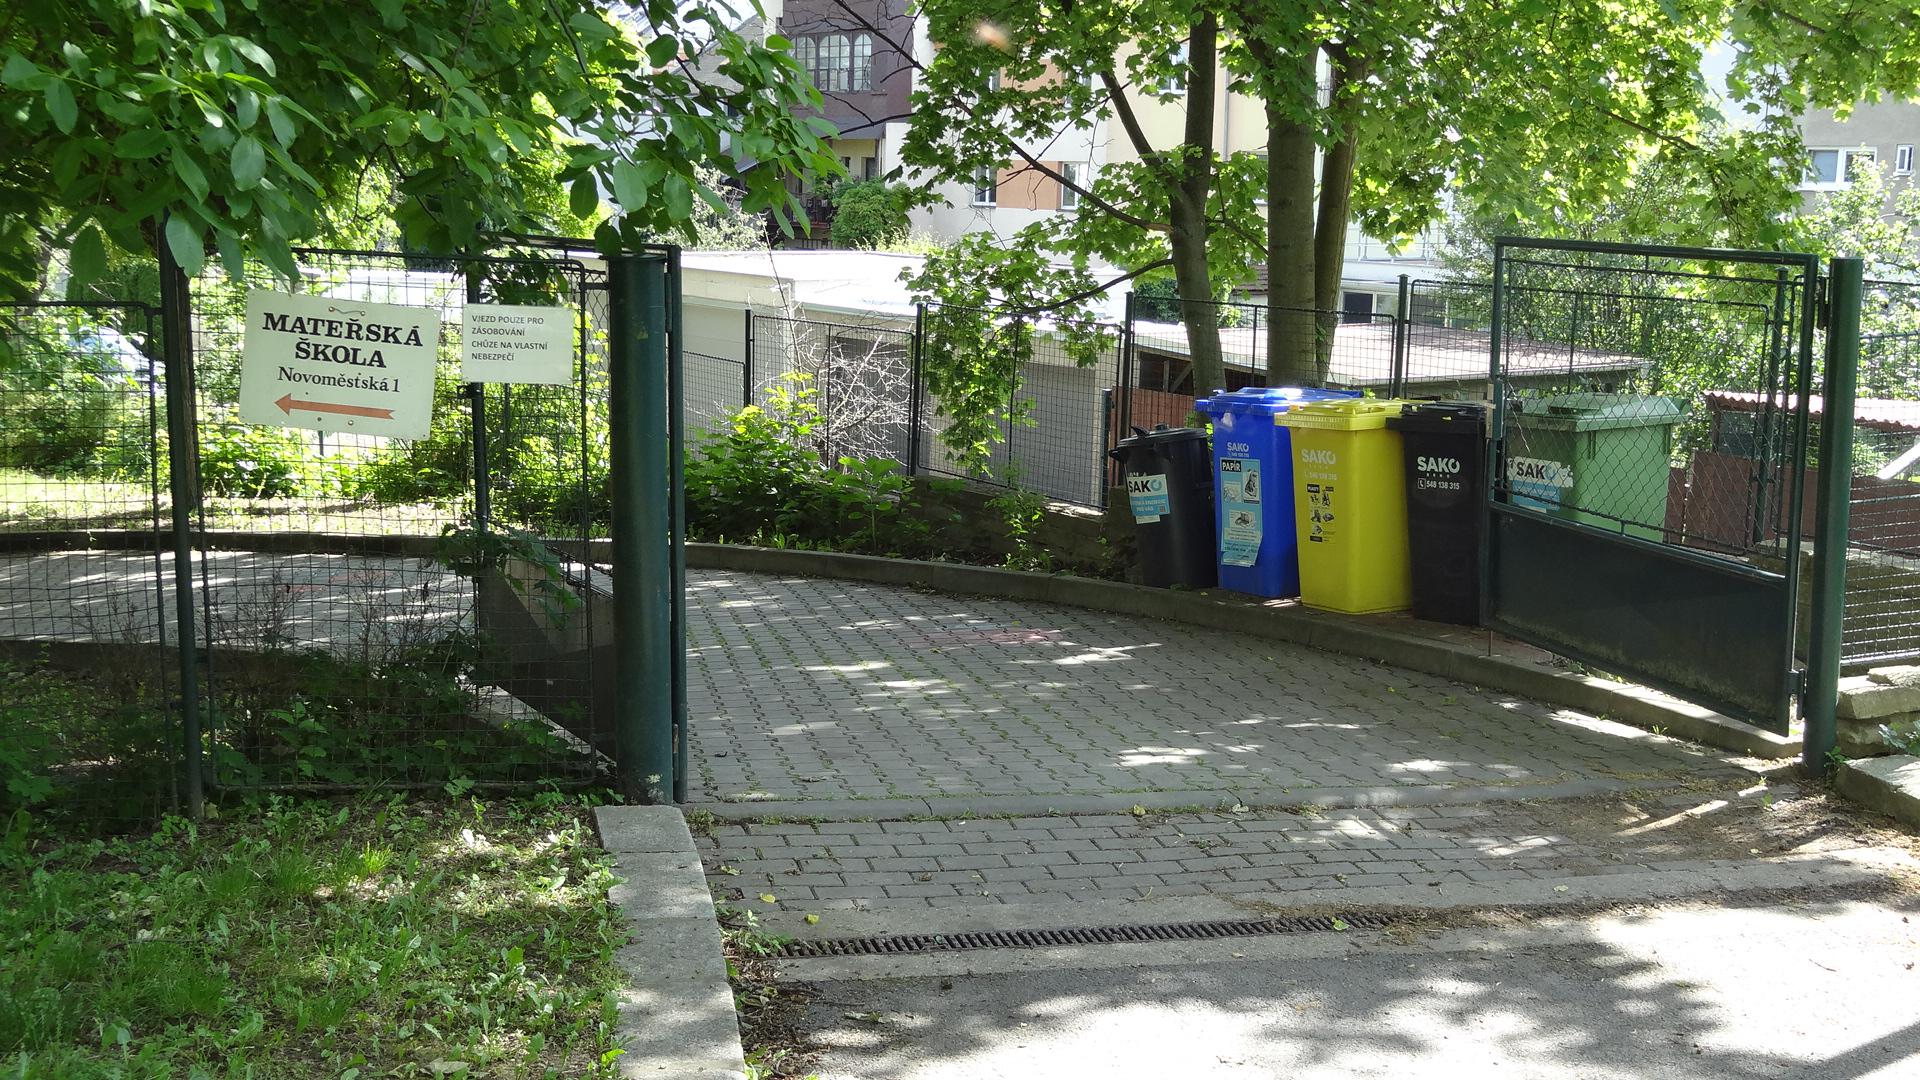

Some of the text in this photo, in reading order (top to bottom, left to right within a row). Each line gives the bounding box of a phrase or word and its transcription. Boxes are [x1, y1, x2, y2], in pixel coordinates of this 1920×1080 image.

[472, 315, 544, 325] VJEZD POUZE PRO
[262, 312, 424, 347] MATEŘSKÁ
[471, 326, 526, 336] ZÁSOBOVÁNÍ
[471, 339, 548, 350] CHŮZE NA VLASTNÍ
[295, 337, 387, 368] ŠKOLA
[471, 352, 515, 361] NEBEZPEČÍ
[277, 366, 401, 393] Novoměstská 1
[1227, 441, 1250, 453] SAKO
[1301, 448, 1337, 465] SAKO
[1222, 460, 1241, 471] PAPÍR
[1417, 456, 1461, 473] SAKO
[1449, 482, 1461, 490] 315
